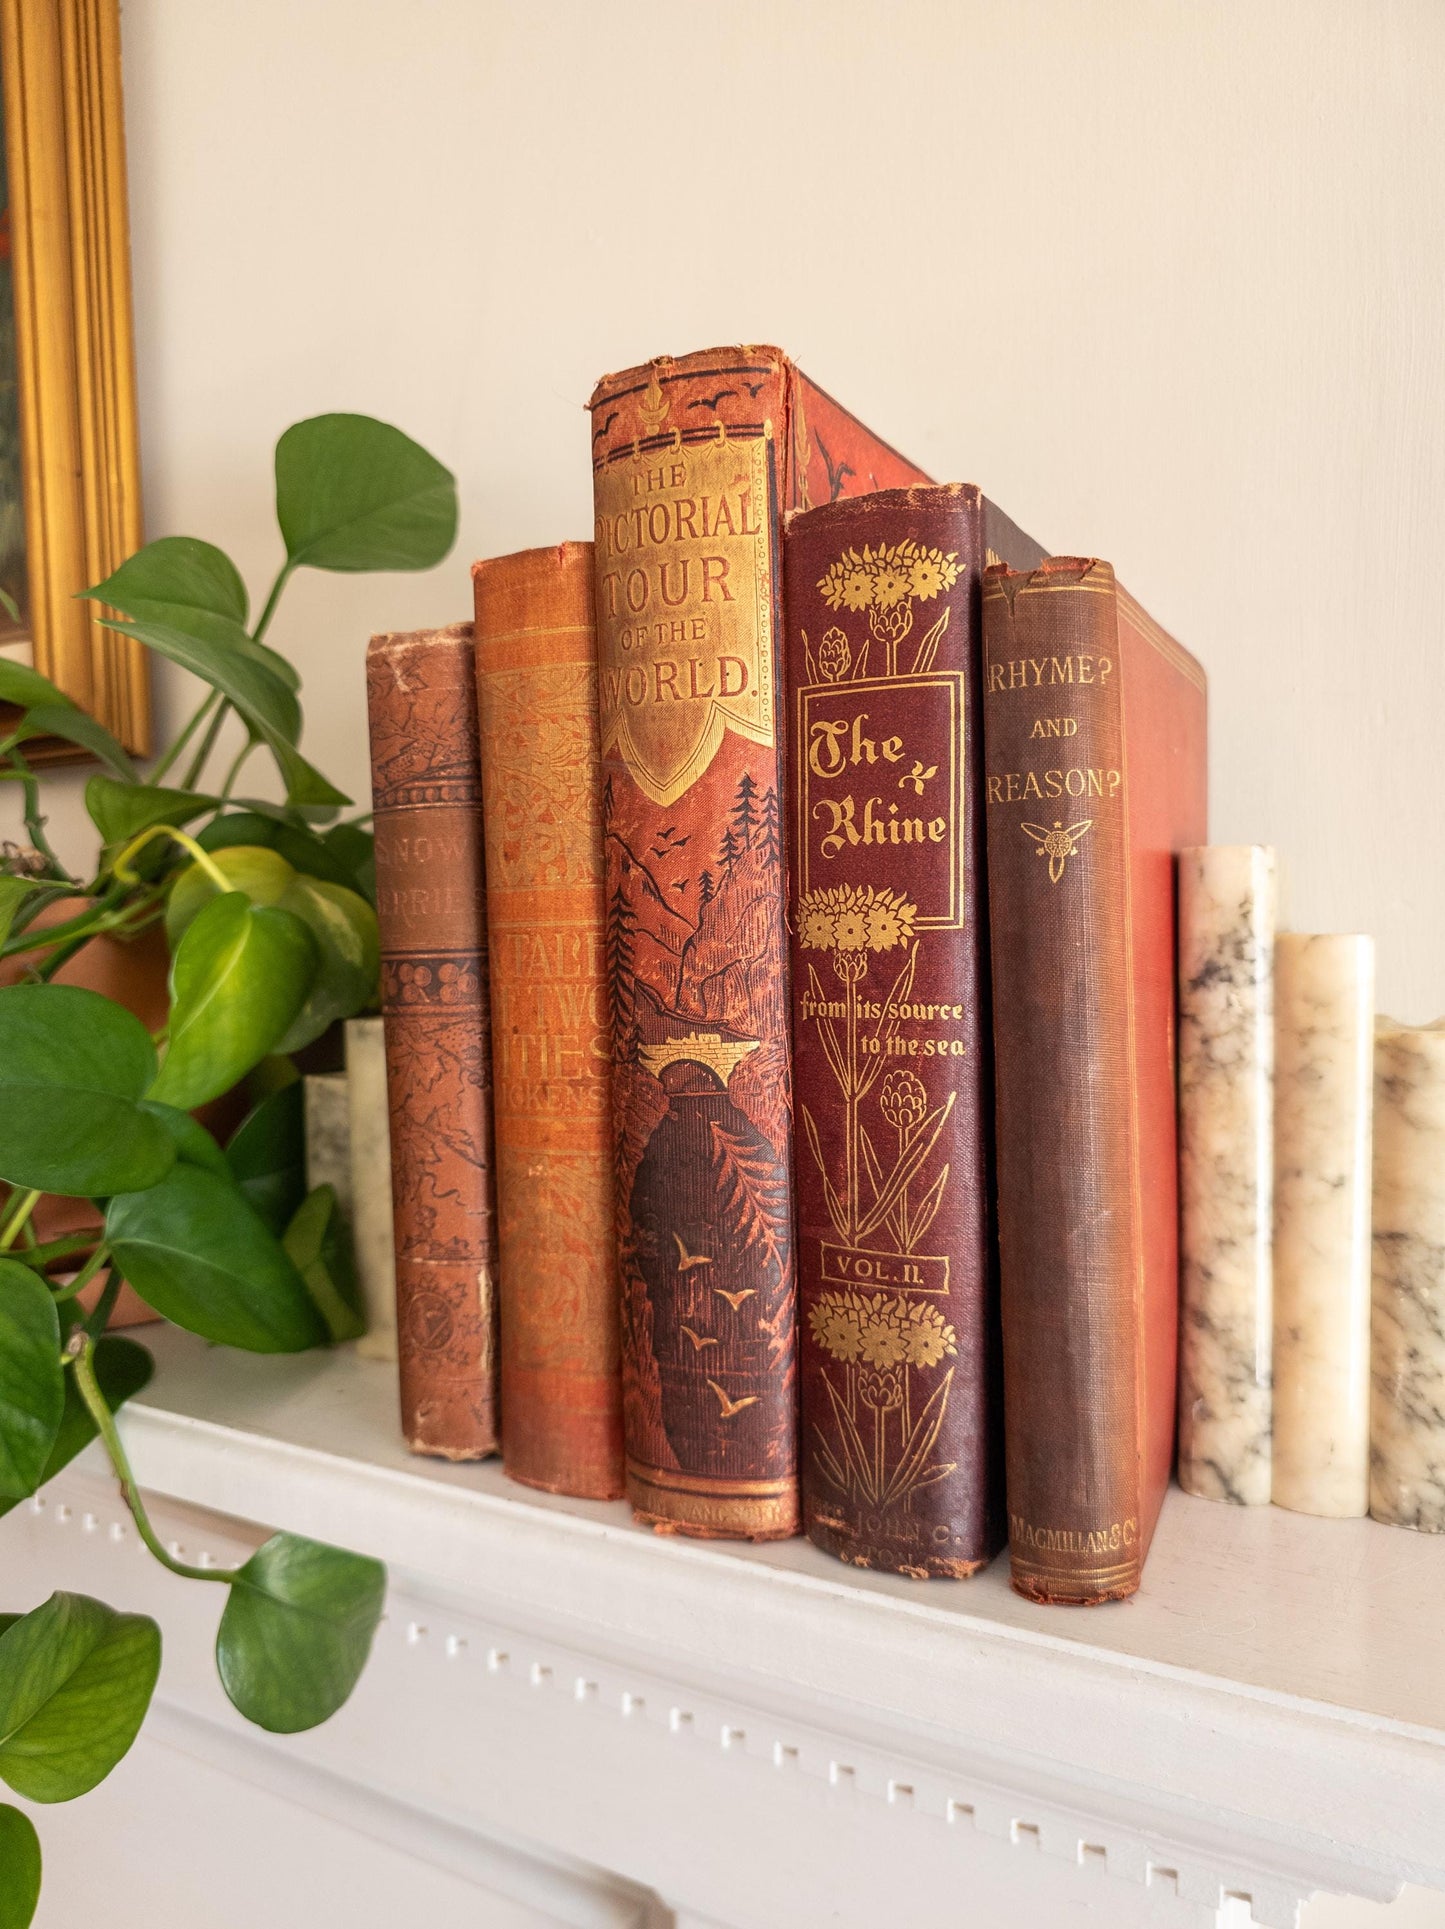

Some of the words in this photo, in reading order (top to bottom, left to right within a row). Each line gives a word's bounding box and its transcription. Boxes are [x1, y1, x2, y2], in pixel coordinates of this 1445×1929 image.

[630, 461, 688, 496] THE
[603, 556, 736, 620] TOUR
[620, 625, 650, 651] OF
[656, 618, 708, 646] THE
[602, 655, 759, 712] WORLD.
[988, 655, 1113, 693] RHYME?
[1029, 717, 1078, 739] AND
[809, 713, 906, 779] The
[986, 768, 1121, 804] REASON?
[812, 794, 947, 859] Rhine
[800, 990, 846, 1021] from
[856, 995, 881, 1018] its
[888, 1002, 963, 1021] source
[861, 1036, 881, 1054] to
[886, 1035, 918, 1056] the
[922, 1039, 966, 1056] sea
[837, 1255, 899, 1282] VOL.
[903, 1264, 924, 1284] II.
